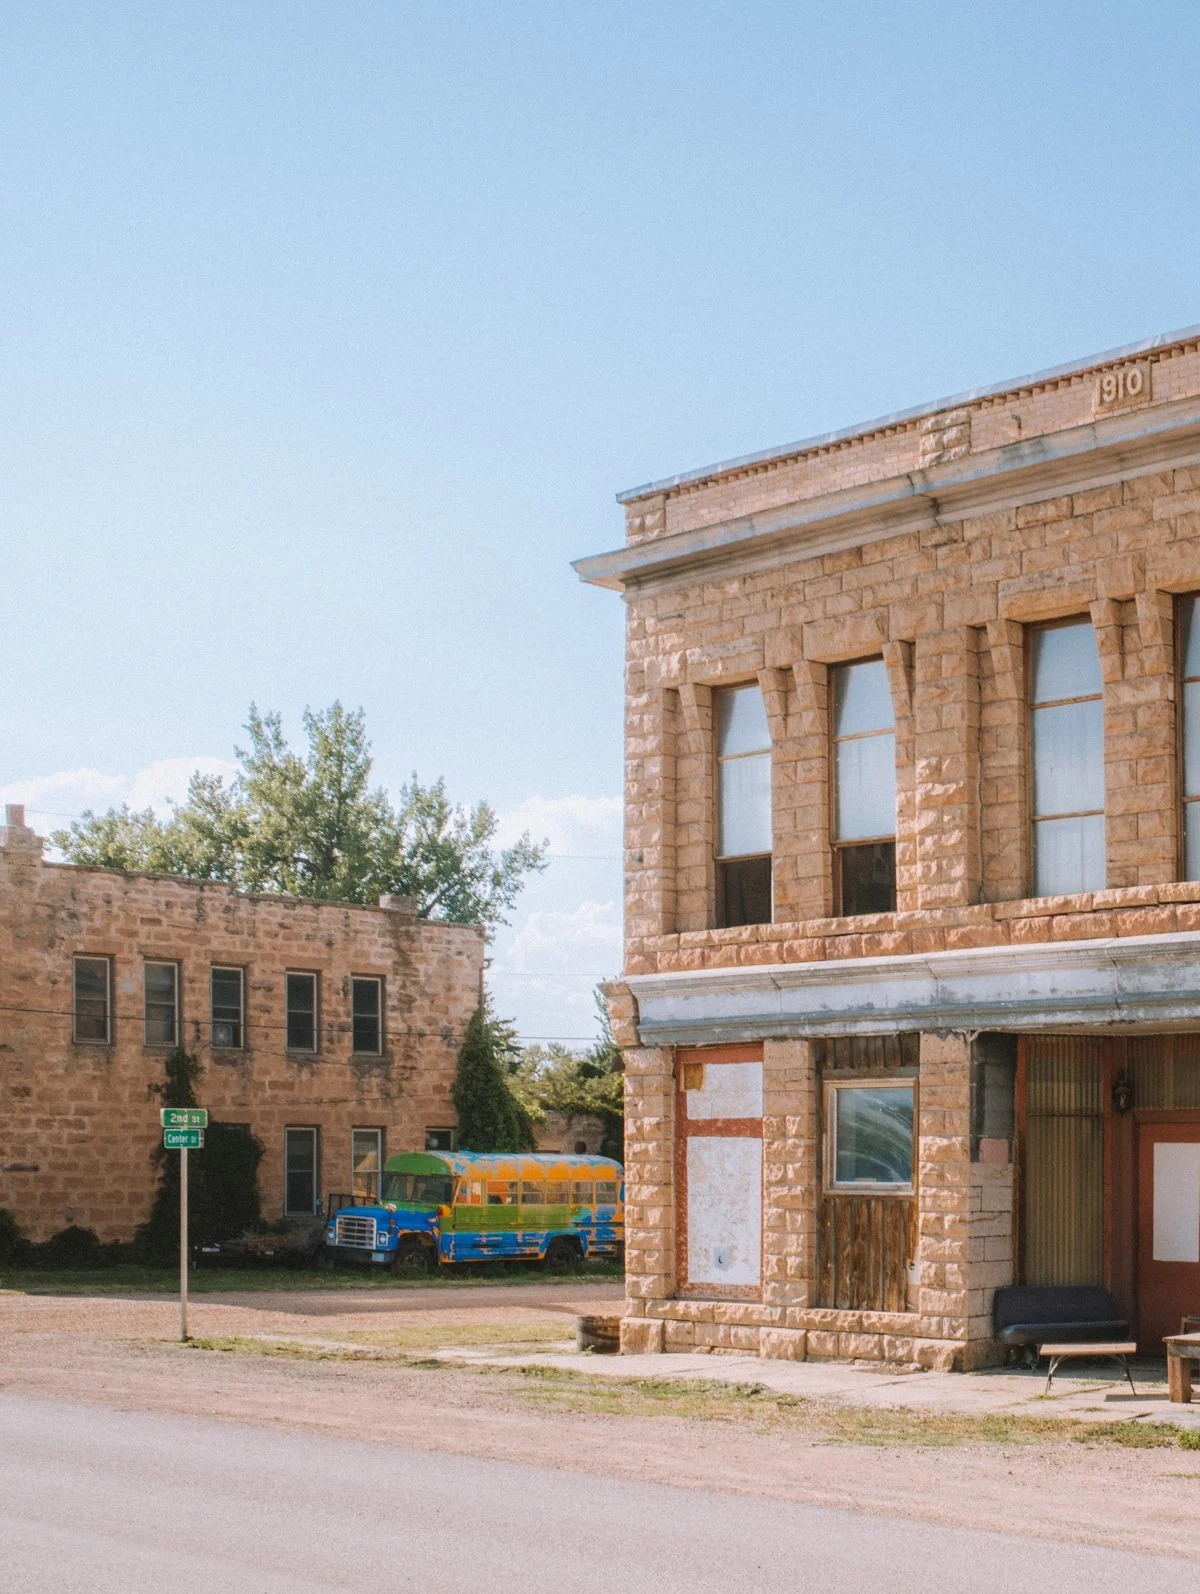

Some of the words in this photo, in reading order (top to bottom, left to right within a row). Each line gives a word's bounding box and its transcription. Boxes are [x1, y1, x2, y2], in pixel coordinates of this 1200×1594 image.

[1095, 367, 1143, 408] 1910
[170, 1113, 189, 1123] 2nd
[167, 1133, 188, 1144] Center
